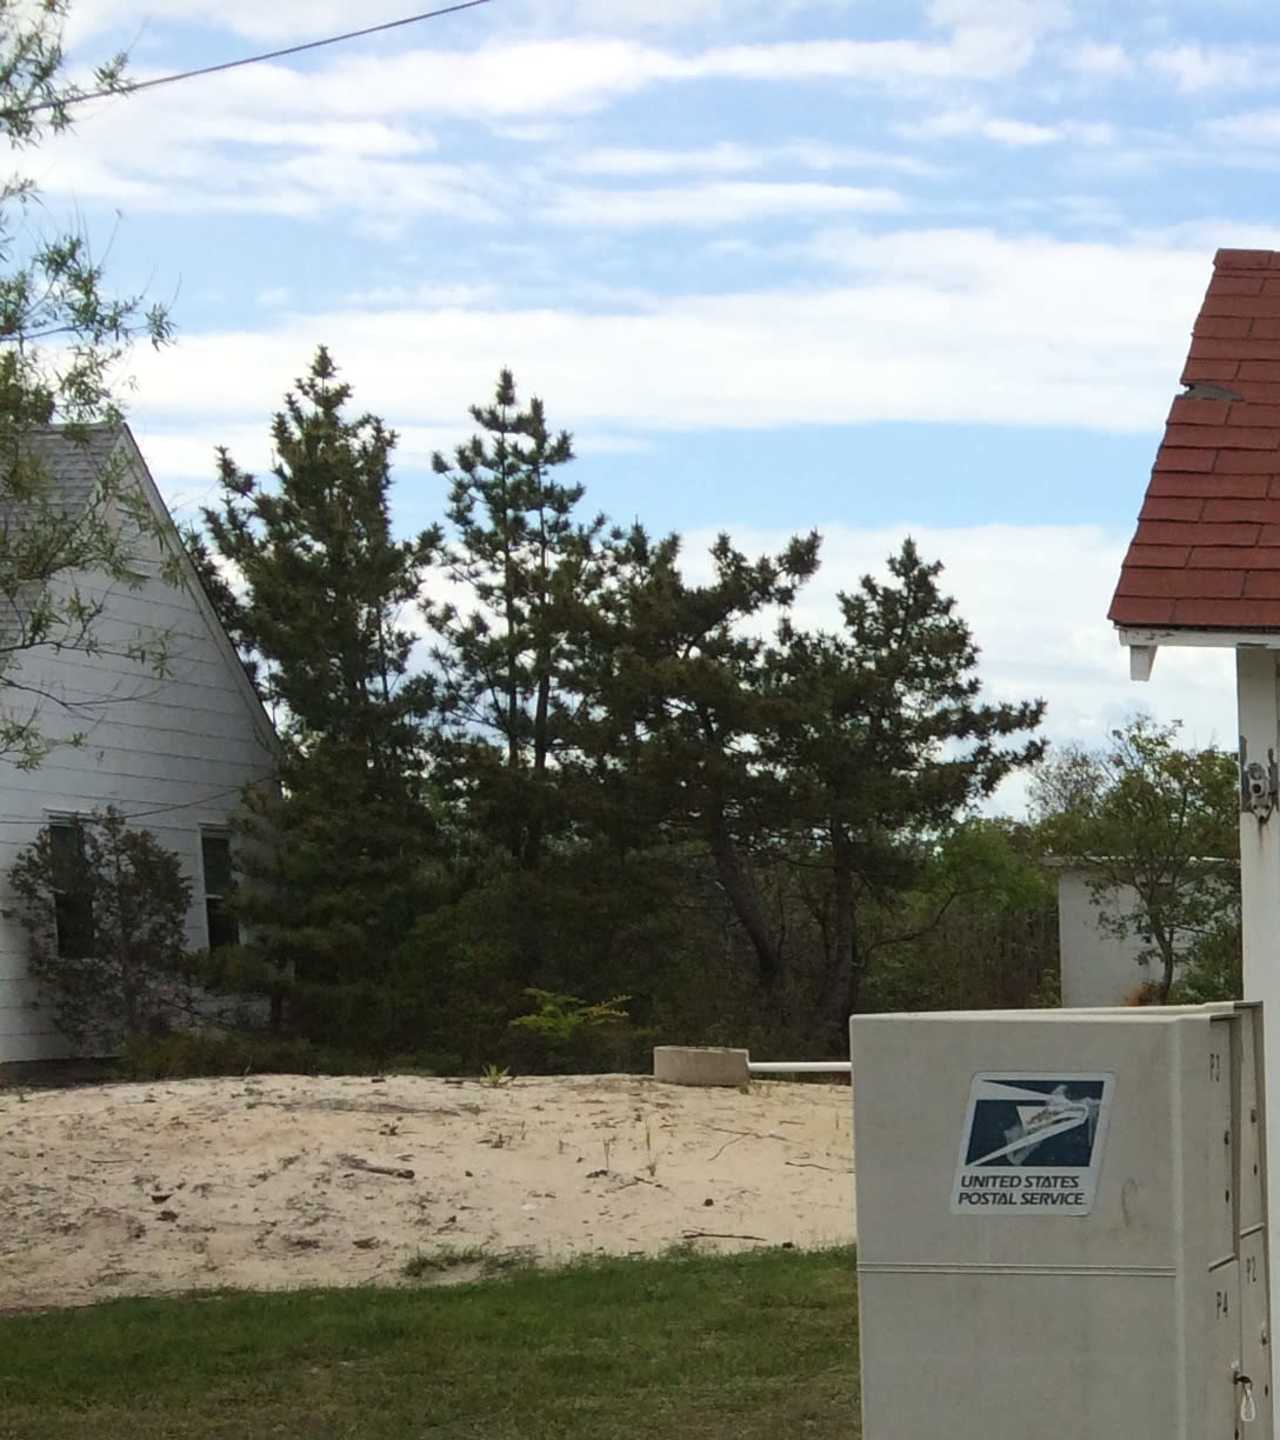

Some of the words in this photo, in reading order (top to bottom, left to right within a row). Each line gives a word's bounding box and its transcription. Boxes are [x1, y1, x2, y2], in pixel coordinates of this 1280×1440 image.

[960, 1175, 1022, 1189] UNITED
[1024, 1175, 1080, 1189] STATES
[957, 1192, 1018, 1206] POSTAL
[1020, 1192, 1085, 1206] SERVICE
